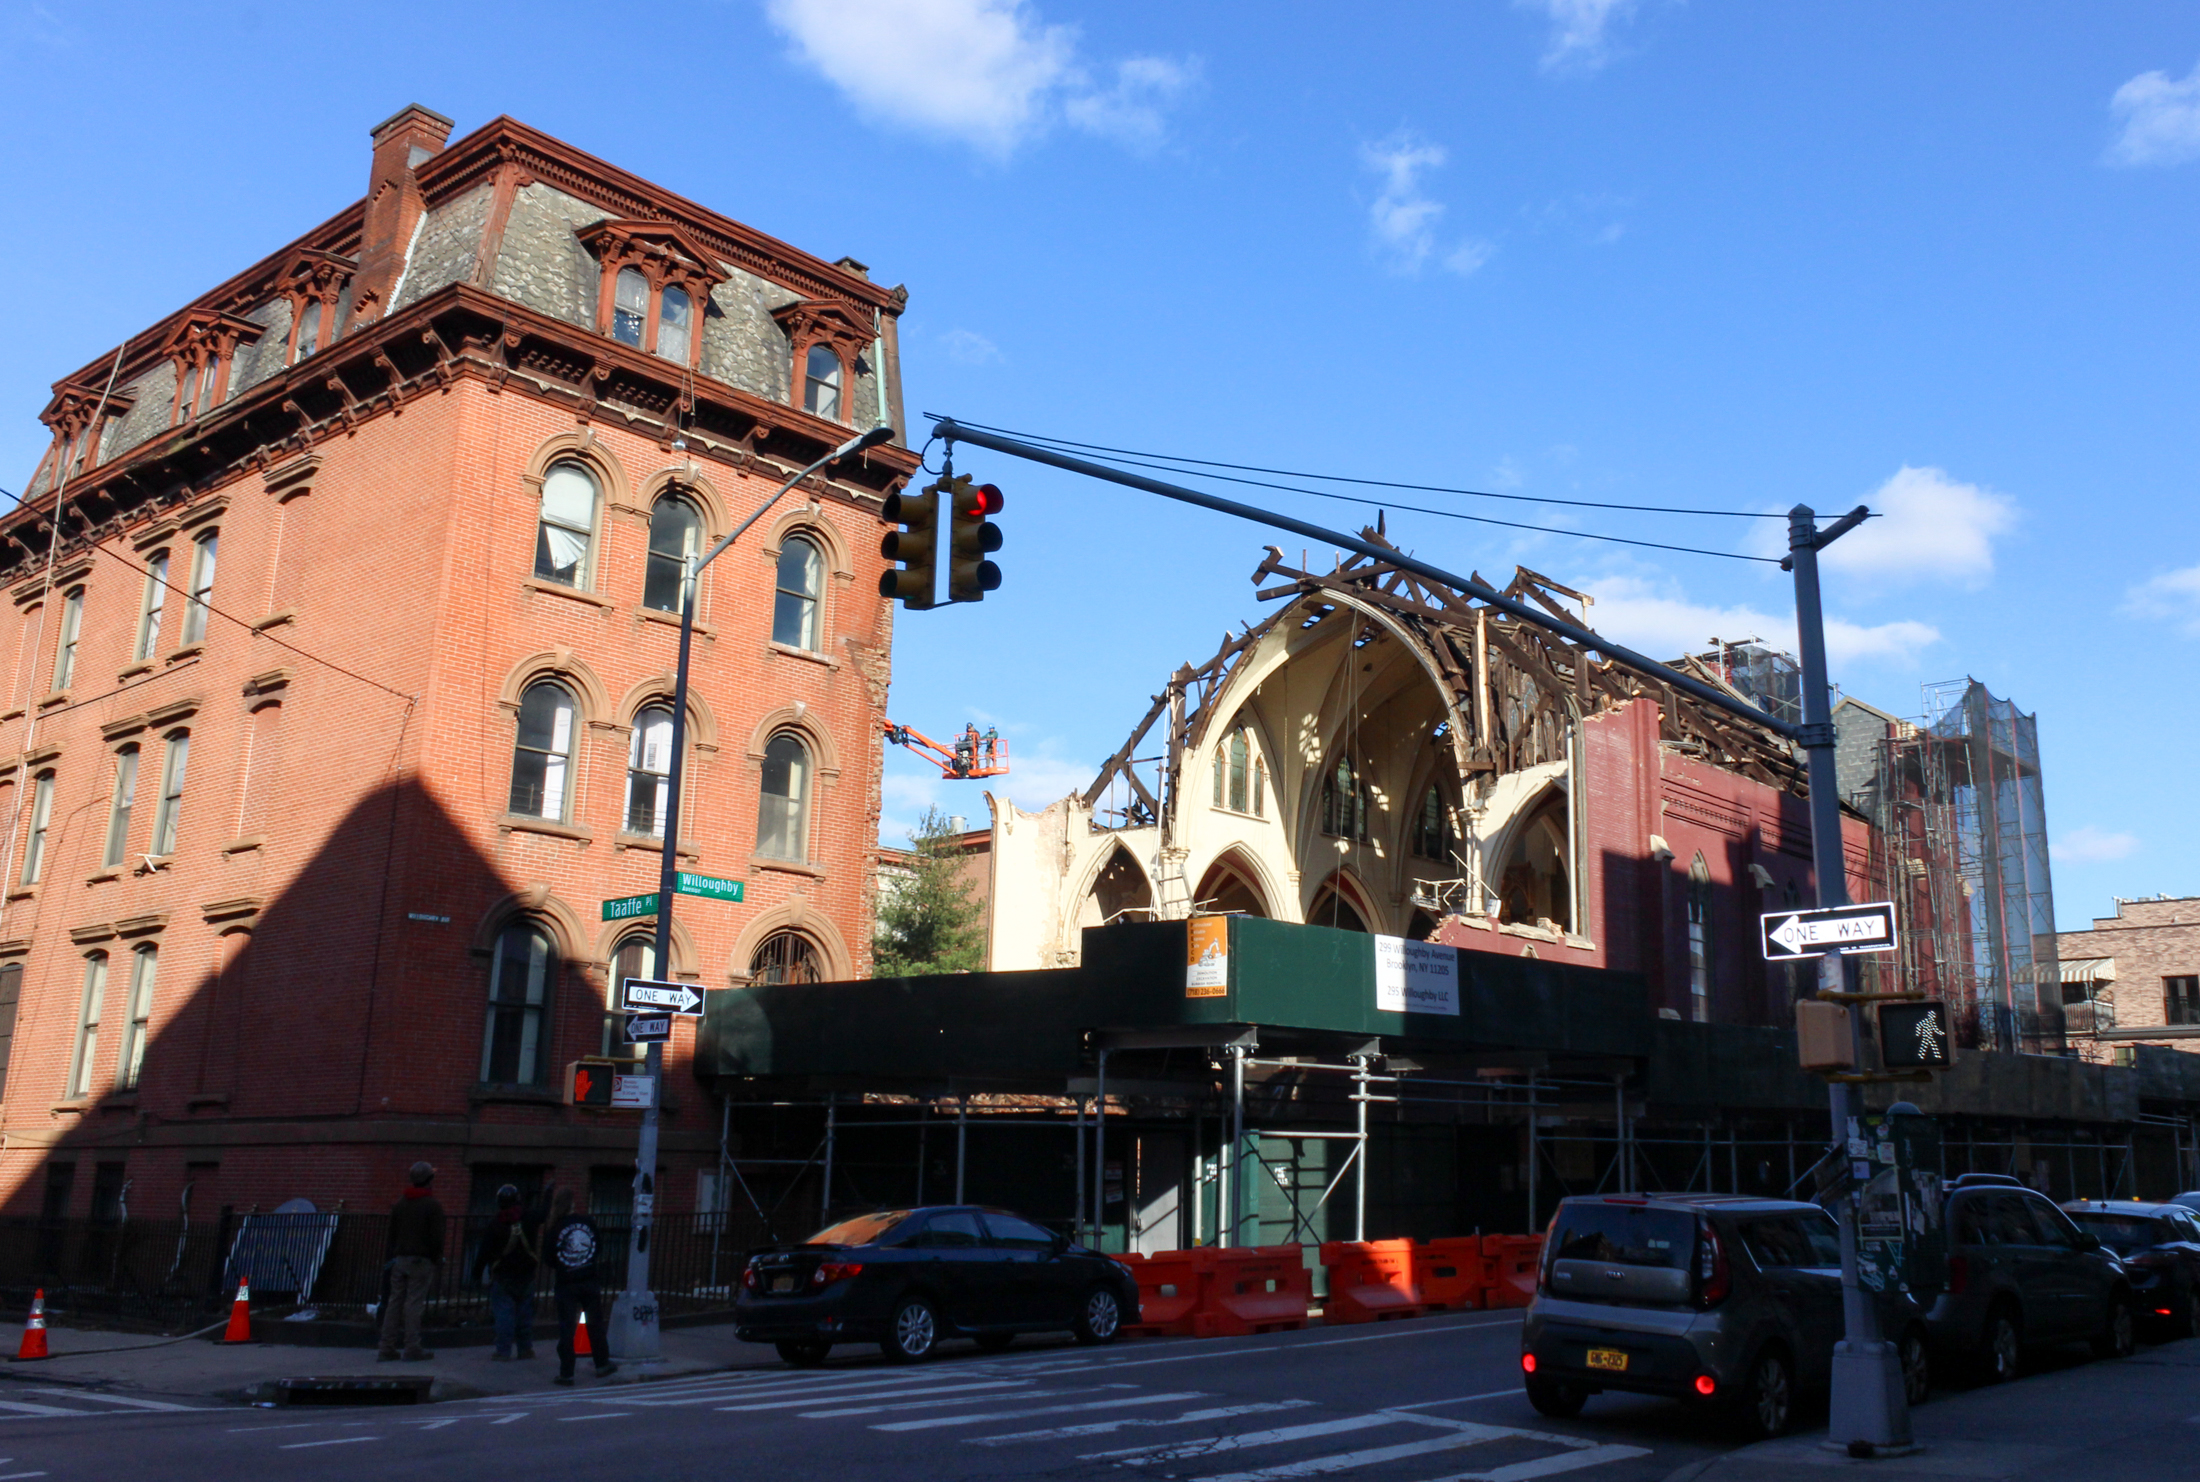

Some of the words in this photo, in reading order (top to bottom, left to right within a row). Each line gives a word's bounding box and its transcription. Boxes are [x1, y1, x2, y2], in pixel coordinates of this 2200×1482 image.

[682, 873, 739, 896] Willoughby
[610, 897, 642, 918] Taaffe
[1784, 925, 1819, 943] ONE
[1837, 919, 1875, 938] WAY
[1379, 942, 1392, 953] 299
[1393, 944, 1430, 960] Willoughby
[1432, 949, 1455, 962] Avenue
[1387, 958, 1418, 974] Brooklyn,
[1419, 962, 1429, 972] NY
[1430, 964, 1449, 976] 11205
[636, 989, 658, 1002] ONE
[669, 992, 692, 1005] WAY
[1387, 985, 1400, 996] 295
[1401, 987, 1437, 1002] Willoughby
[1438, 991, 1449, 1002] LLC
[631, 1022, 644, 1034] ONE
[650, 1021, 665, 1032] WAY
